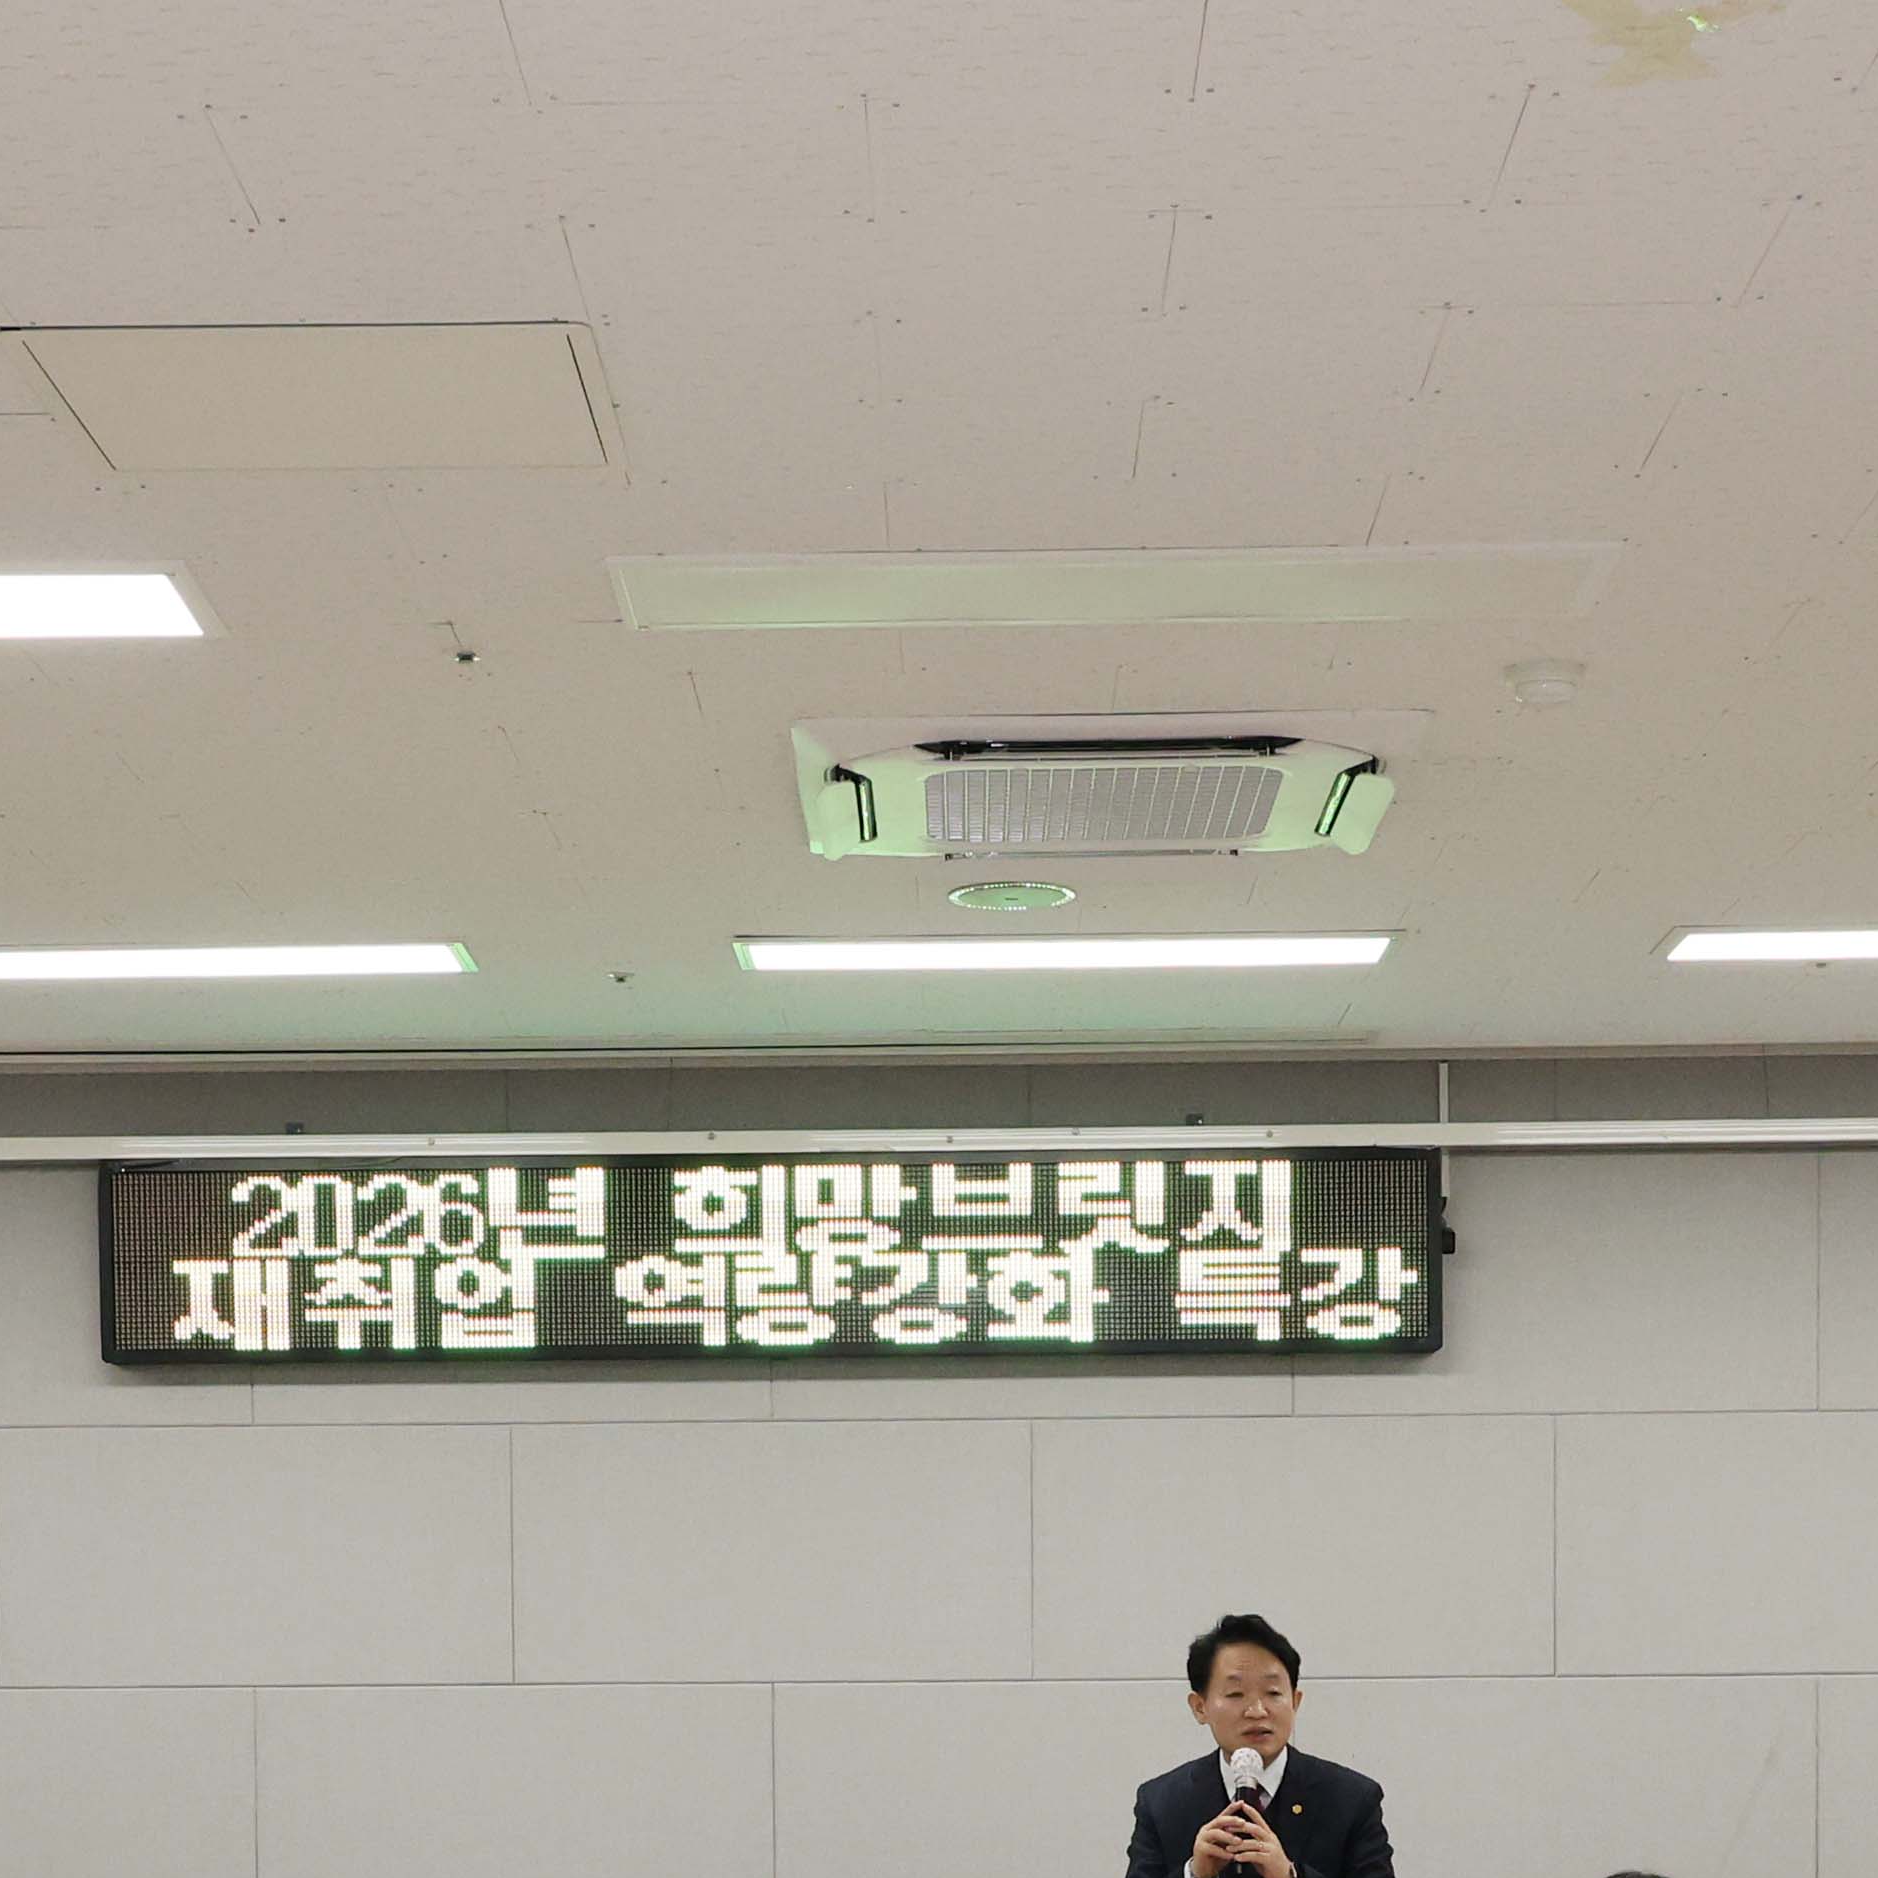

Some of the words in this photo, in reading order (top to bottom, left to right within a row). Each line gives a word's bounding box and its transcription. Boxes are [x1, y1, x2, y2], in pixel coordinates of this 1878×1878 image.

[231, 1166, 605, 1259] 2026년
[674, 1160, 1291, 1256] 희망브릿지
[171, 1255, 537, 1350] 재취업
[615, 1250, 1110, 1346] 역량강화
[1174, 1247, 1419, 1341] 특강
